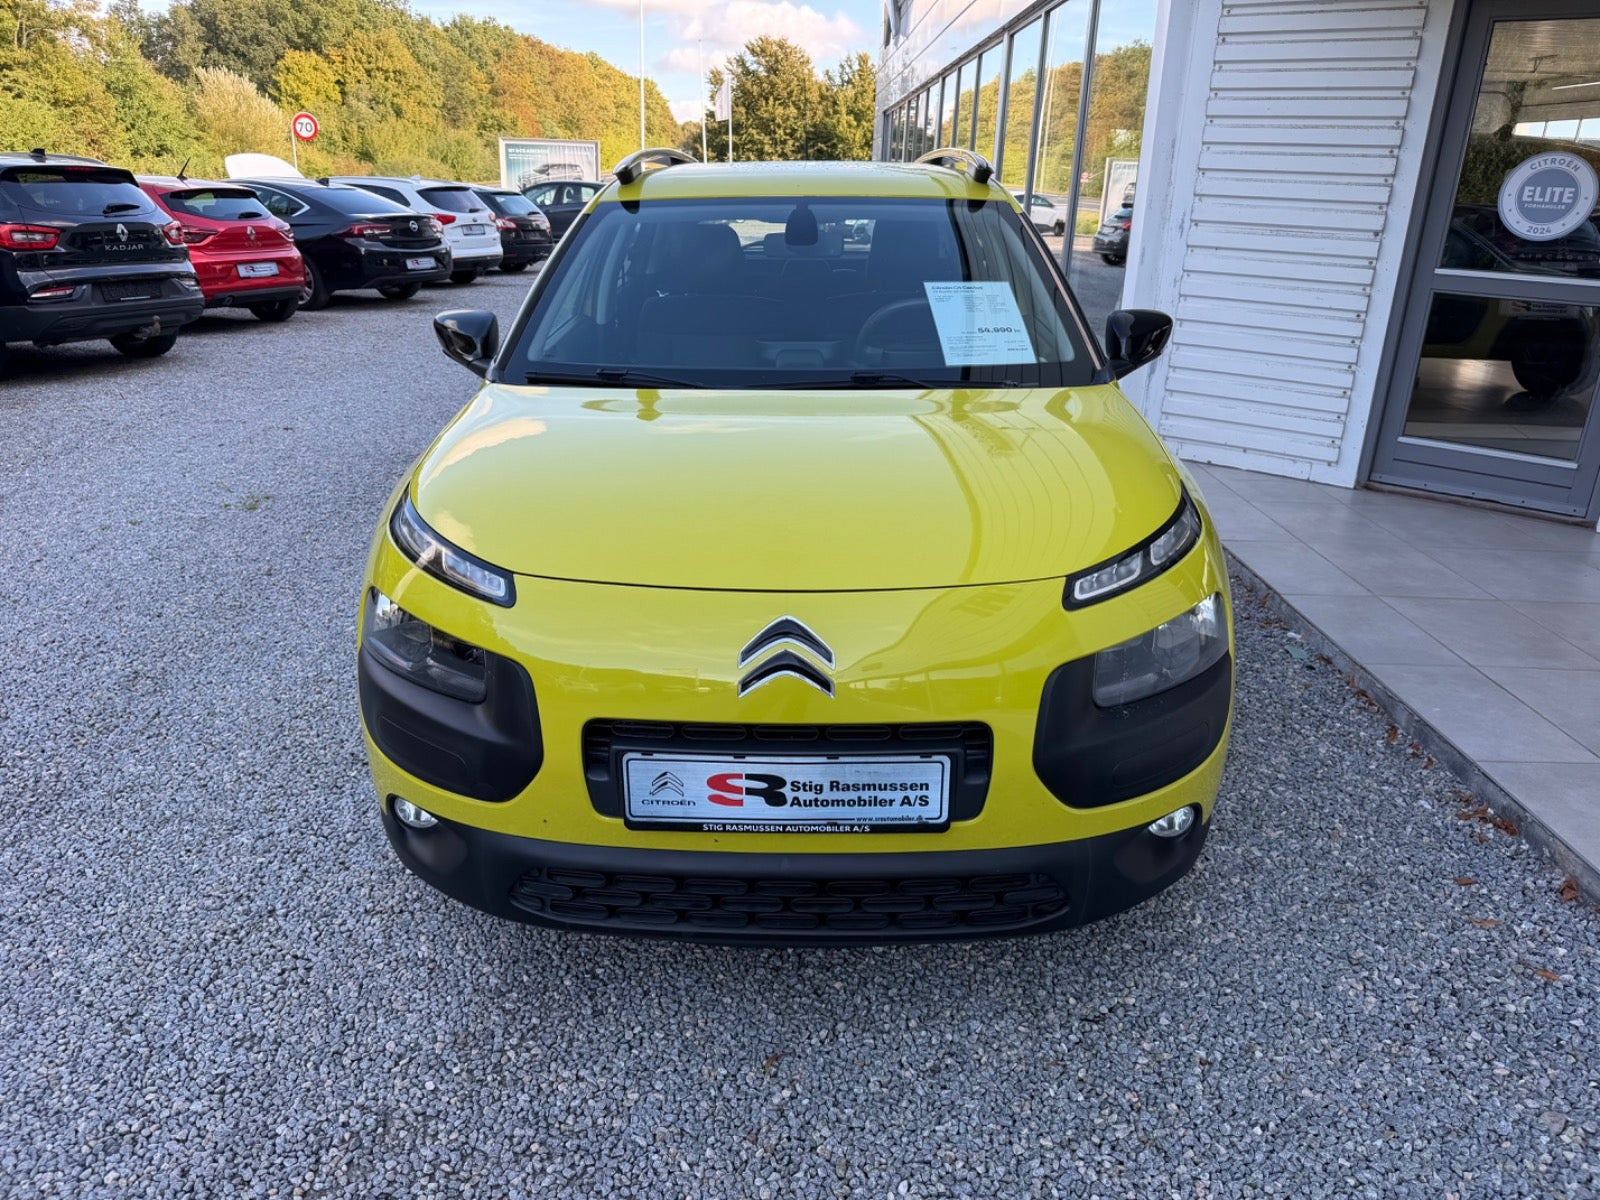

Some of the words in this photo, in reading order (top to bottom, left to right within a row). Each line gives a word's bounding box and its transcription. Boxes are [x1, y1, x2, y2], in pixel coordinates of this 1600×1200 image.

[297, 121, 313, 133] 70
[1529, 157, 1581, 173] CITROËN
[1522, 186, 1576, 204] ELITE
[1526, 225, 1552, 235] 2024
[104, 243, 145, 251] KADJAR
[641, 798, 696, 807] CITROËN
[706, 772, 788, 808] SR
[790, 780, 824, 795] Stig
[829, 780, 930, 793] Rasmussen
[789, 795, 896, 808] Automobiler
[899, 795, 930, 807] A/S
[702, 823, 724, 832] STIG
[725, 824, 783, 833] RASMUSSEN
[785, 825, 851, 833] AUTOMOBILER
[852, 824, 871, 833] A/S
